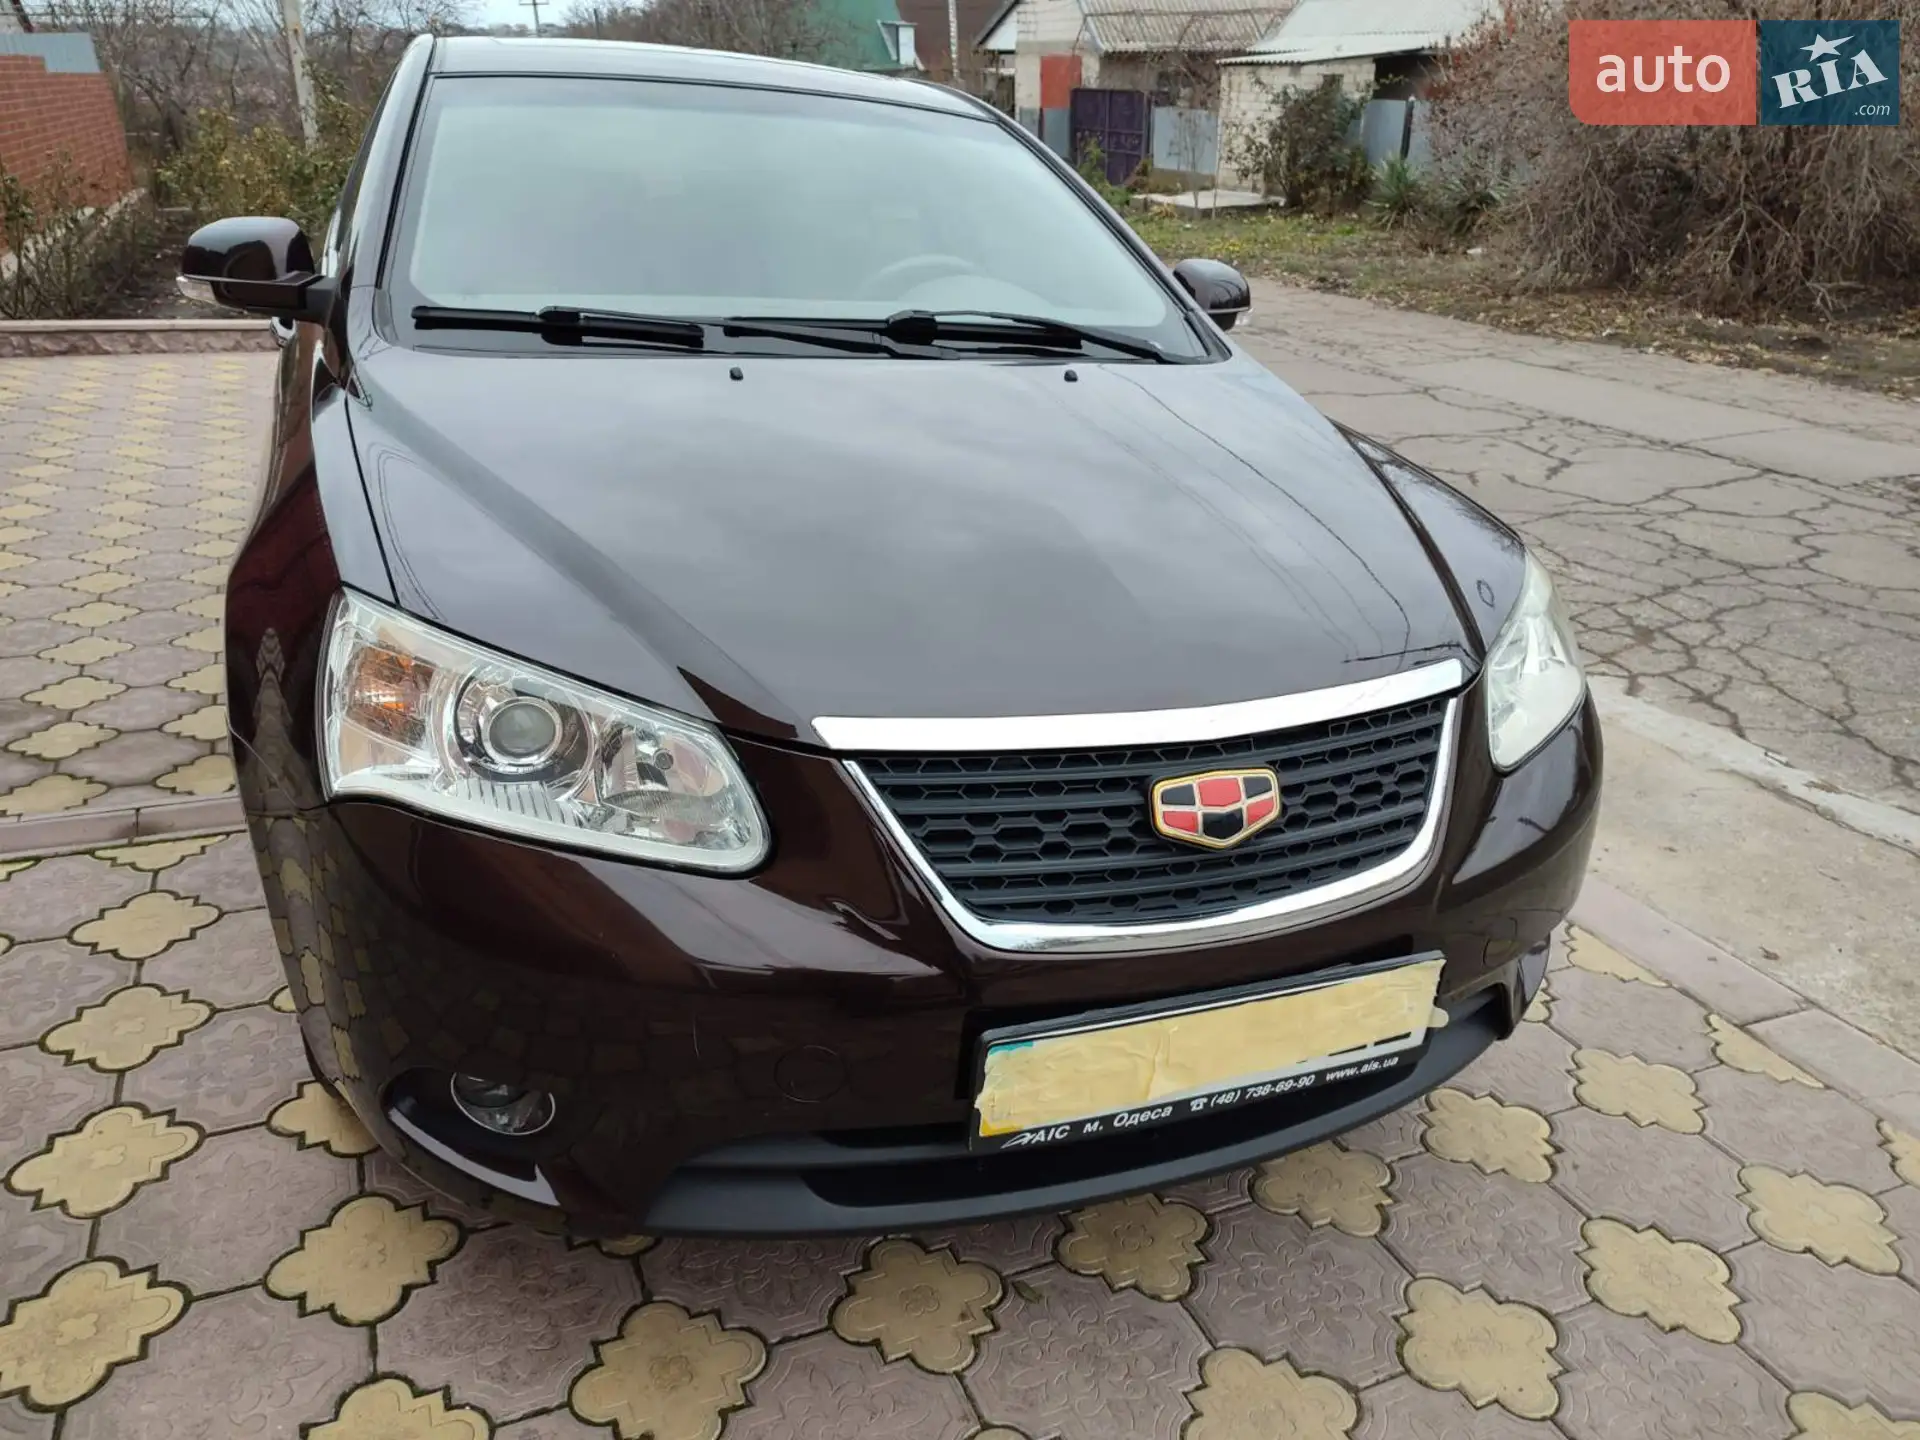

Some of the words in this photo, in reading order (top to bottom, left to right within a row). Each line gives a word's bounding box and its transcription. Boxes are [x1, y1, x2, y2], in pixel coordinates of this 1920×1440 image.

[1113, 1105, 1174, 1128] Одеса
[1210, 1091, 1241, 1109] (48)
[1244, 1074, 1316, 1099] 738-69-90
[1325, 1056, 1400, 1082] www.ais.ua
